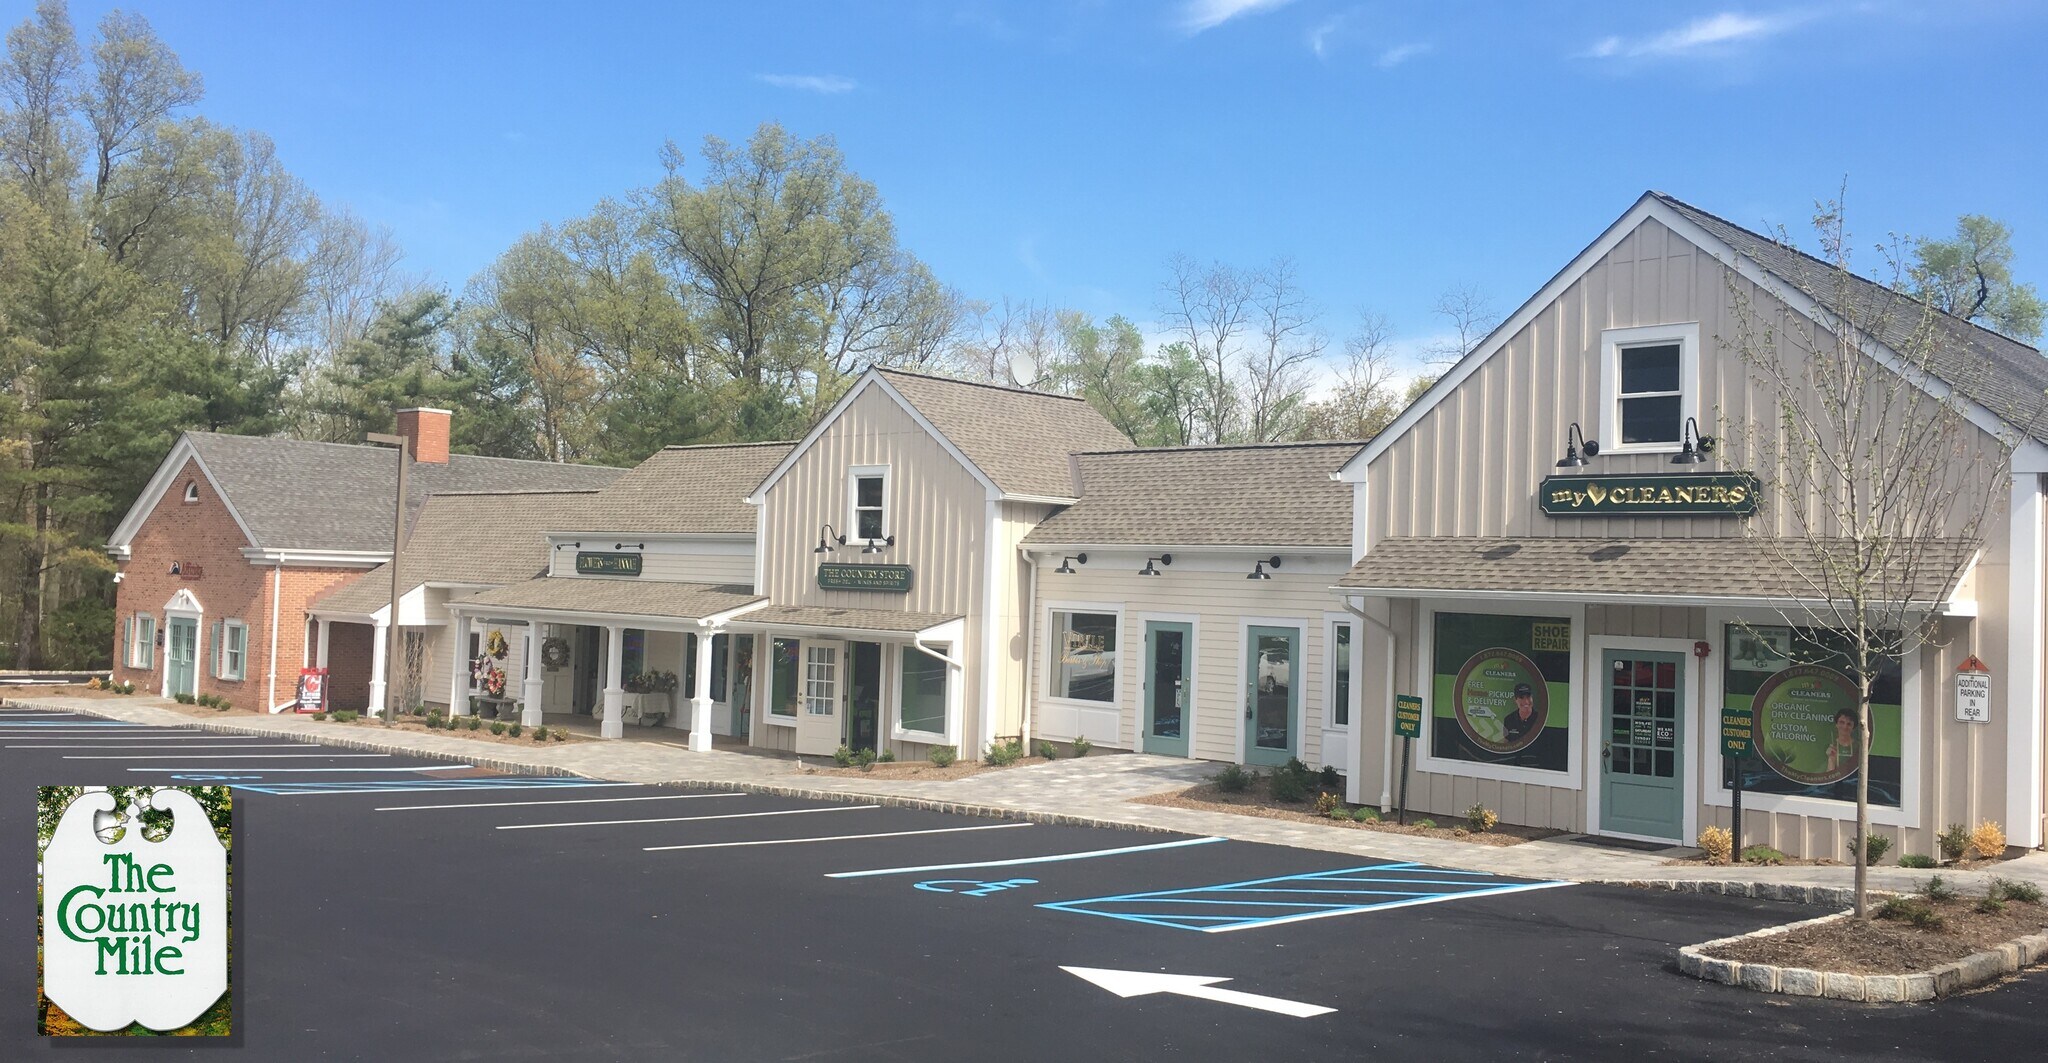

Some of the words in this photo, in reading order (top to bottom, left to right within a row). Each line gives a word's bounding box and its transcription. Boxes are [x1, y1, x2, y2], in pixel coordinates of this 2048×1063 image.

[1552, 488, 1588, 507] my
[1609, 486, 1747, 504] CLEANERS
[824, 569, 840, 578] THE
[841, 569, 879, 580] COUNTRY
[880, 571, 906, 580] STORE
[1534, 626, 1569, 638] SHOE
[1534, 637, 1569, 650] REPAIR
[1970, 660, 1977, 668] R
[1468, 681, 1485, 689] FREE
[1958, 680, 1988, 689] ADDITIONAL
[1489, 691, 1515, 699] PICKUP
[1790, 690, 1832, 698] CLEANERS
[1960, 688, 1985, 698] PARKING
[1397, 701, 1421, 711] CLEANERS
[1474, 697, 1507, 706] DELIVERY
[1969, 699, 1976, 707] IN
[1771, 702, 1811, 712] ORGANIC
[1397, 711, 1420, 721] CUSTOMER
[1771, 711, 1789, 719] DRY
[1790, 712, 1835, 723] CLEANING
[1964, 708, 1980, 717] REAR
[1723, 716, 1752, 726] CLEANERS
[1400, 722, 1416, 731] ONLY
[1771, 722, 1808, 732] CUSTOM
[1723, 728, 1751, 738] CUSTOMER
[1771, 731, 1817, 742] TAILORING
[1727, 740, 1747, 750] ONLY
